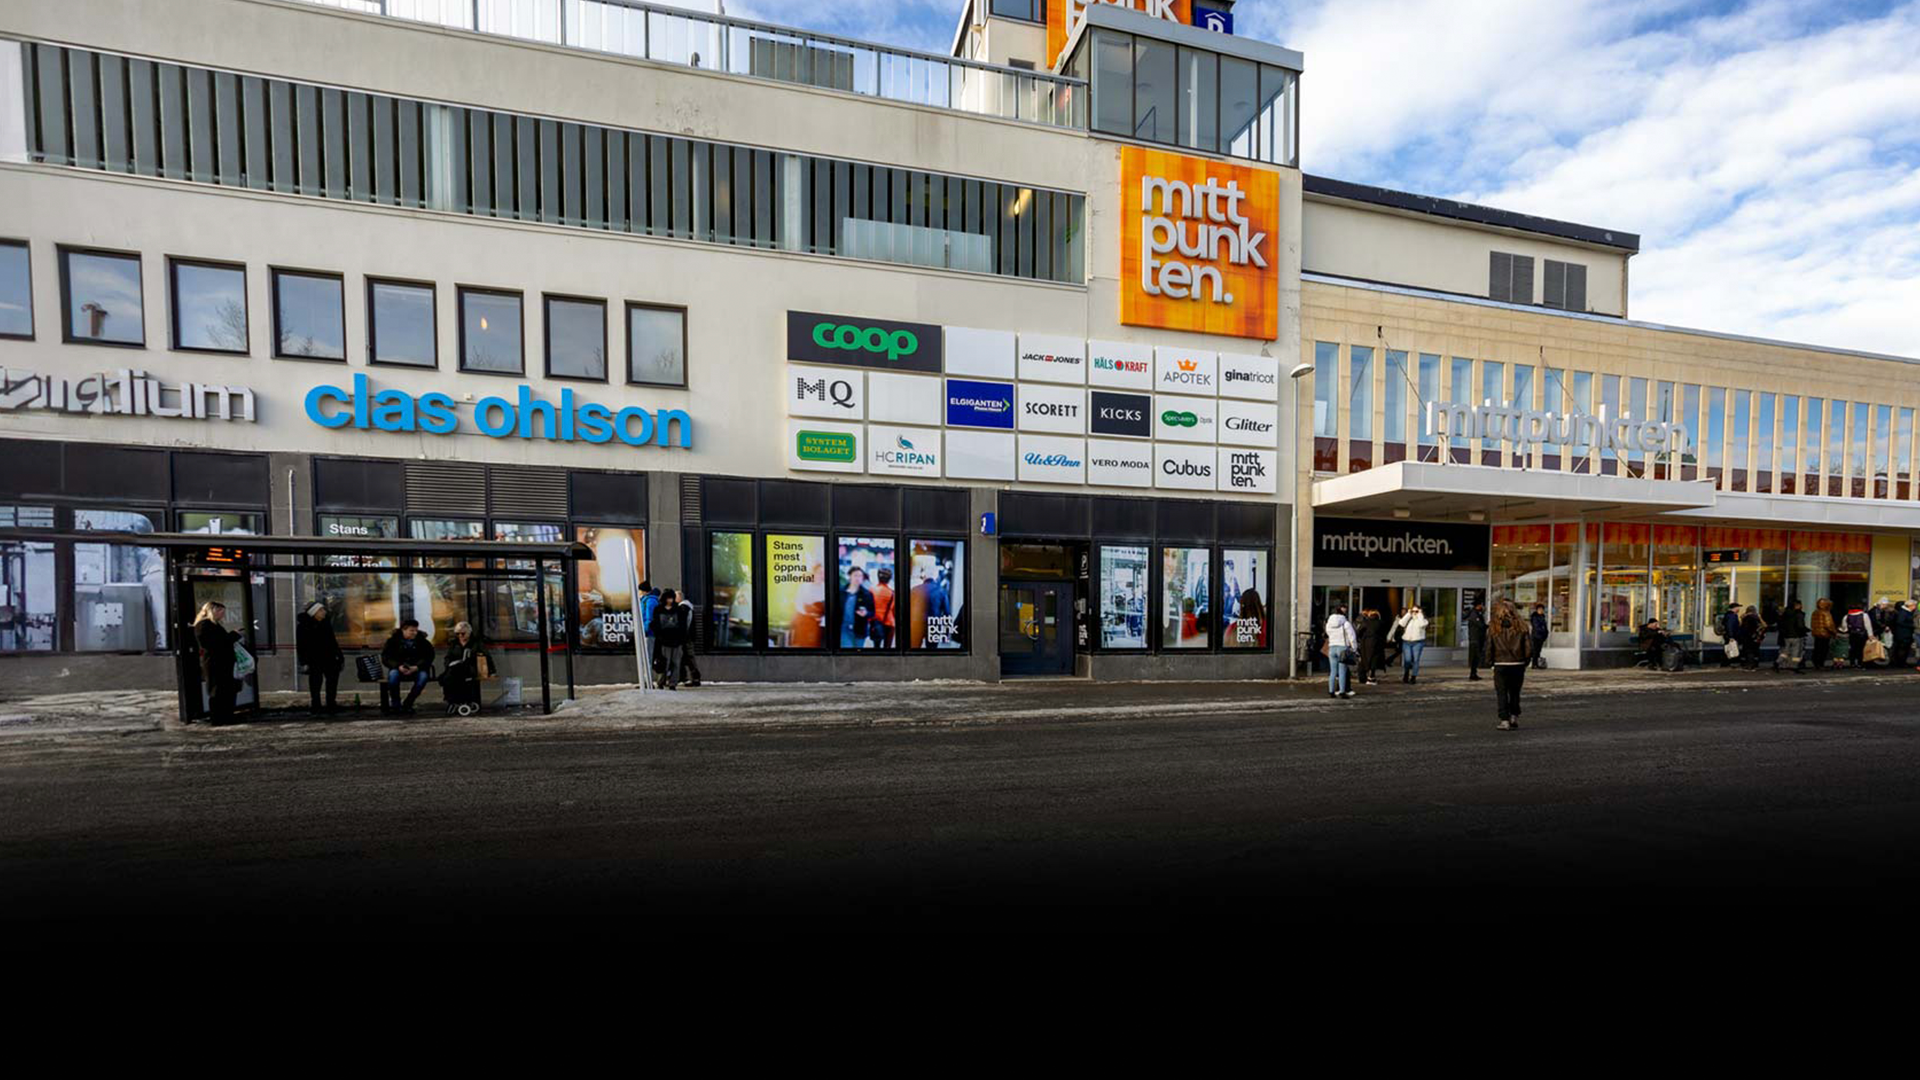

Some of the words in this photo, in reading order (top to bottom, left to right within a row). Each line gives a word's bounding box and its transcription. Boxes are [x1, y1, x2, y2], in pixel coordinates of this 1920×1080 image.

[1142, 216, 1269, 269] punk
[1142, 260, 1234, 304] ten.
[812, 322, 919, 361] coop
[1022, 353, 1045, 361] JACK
[1053, 356, 1080, 364] JONES
[1094, 357, 1114, 370] HÄLS
[1124, 361, 1148, 373] KRAFT
[1163, 371, 1212, 386] APOTEK
[797, 377, 856, 409] MQ
[950, 397, 1003, 408] ELGIGANTEN
[304, 373, 459, 435] clas
[474, 384, 692, 449] ohlson
[1025, 401, 1079, 418] SCORETT
[1099, 406, 1143, 421] KICKS
[1225, 416, 1273, 433] Glitter
[805, 436, 847, 447] SYSTEM
[802, 445, 851, 455] BOLAGET
[1091, 458, 1119, 468] VERO
[1120, 460, 1150, 469] MODA
[1162, 459, 1212, 477] Cubus
[1231, 463, 1266, 477] punk
[1231, 474, 1257, 488] ten.
[329, 523, 369, 535] Stans
[773, 540, 804, 551] Stans
[773, 552, 801, 562] mest
[773, 562, 808, 575] öppna
[773, 573, 815, 584] galleria!
[927, 623, 959, 635] punk
[1236, 625, 1262, 635] punk
[602, 632, 630, 642] ten.
[927, 633, 951, 644] ten.
[1236, 632, 1256, 643] ten.
